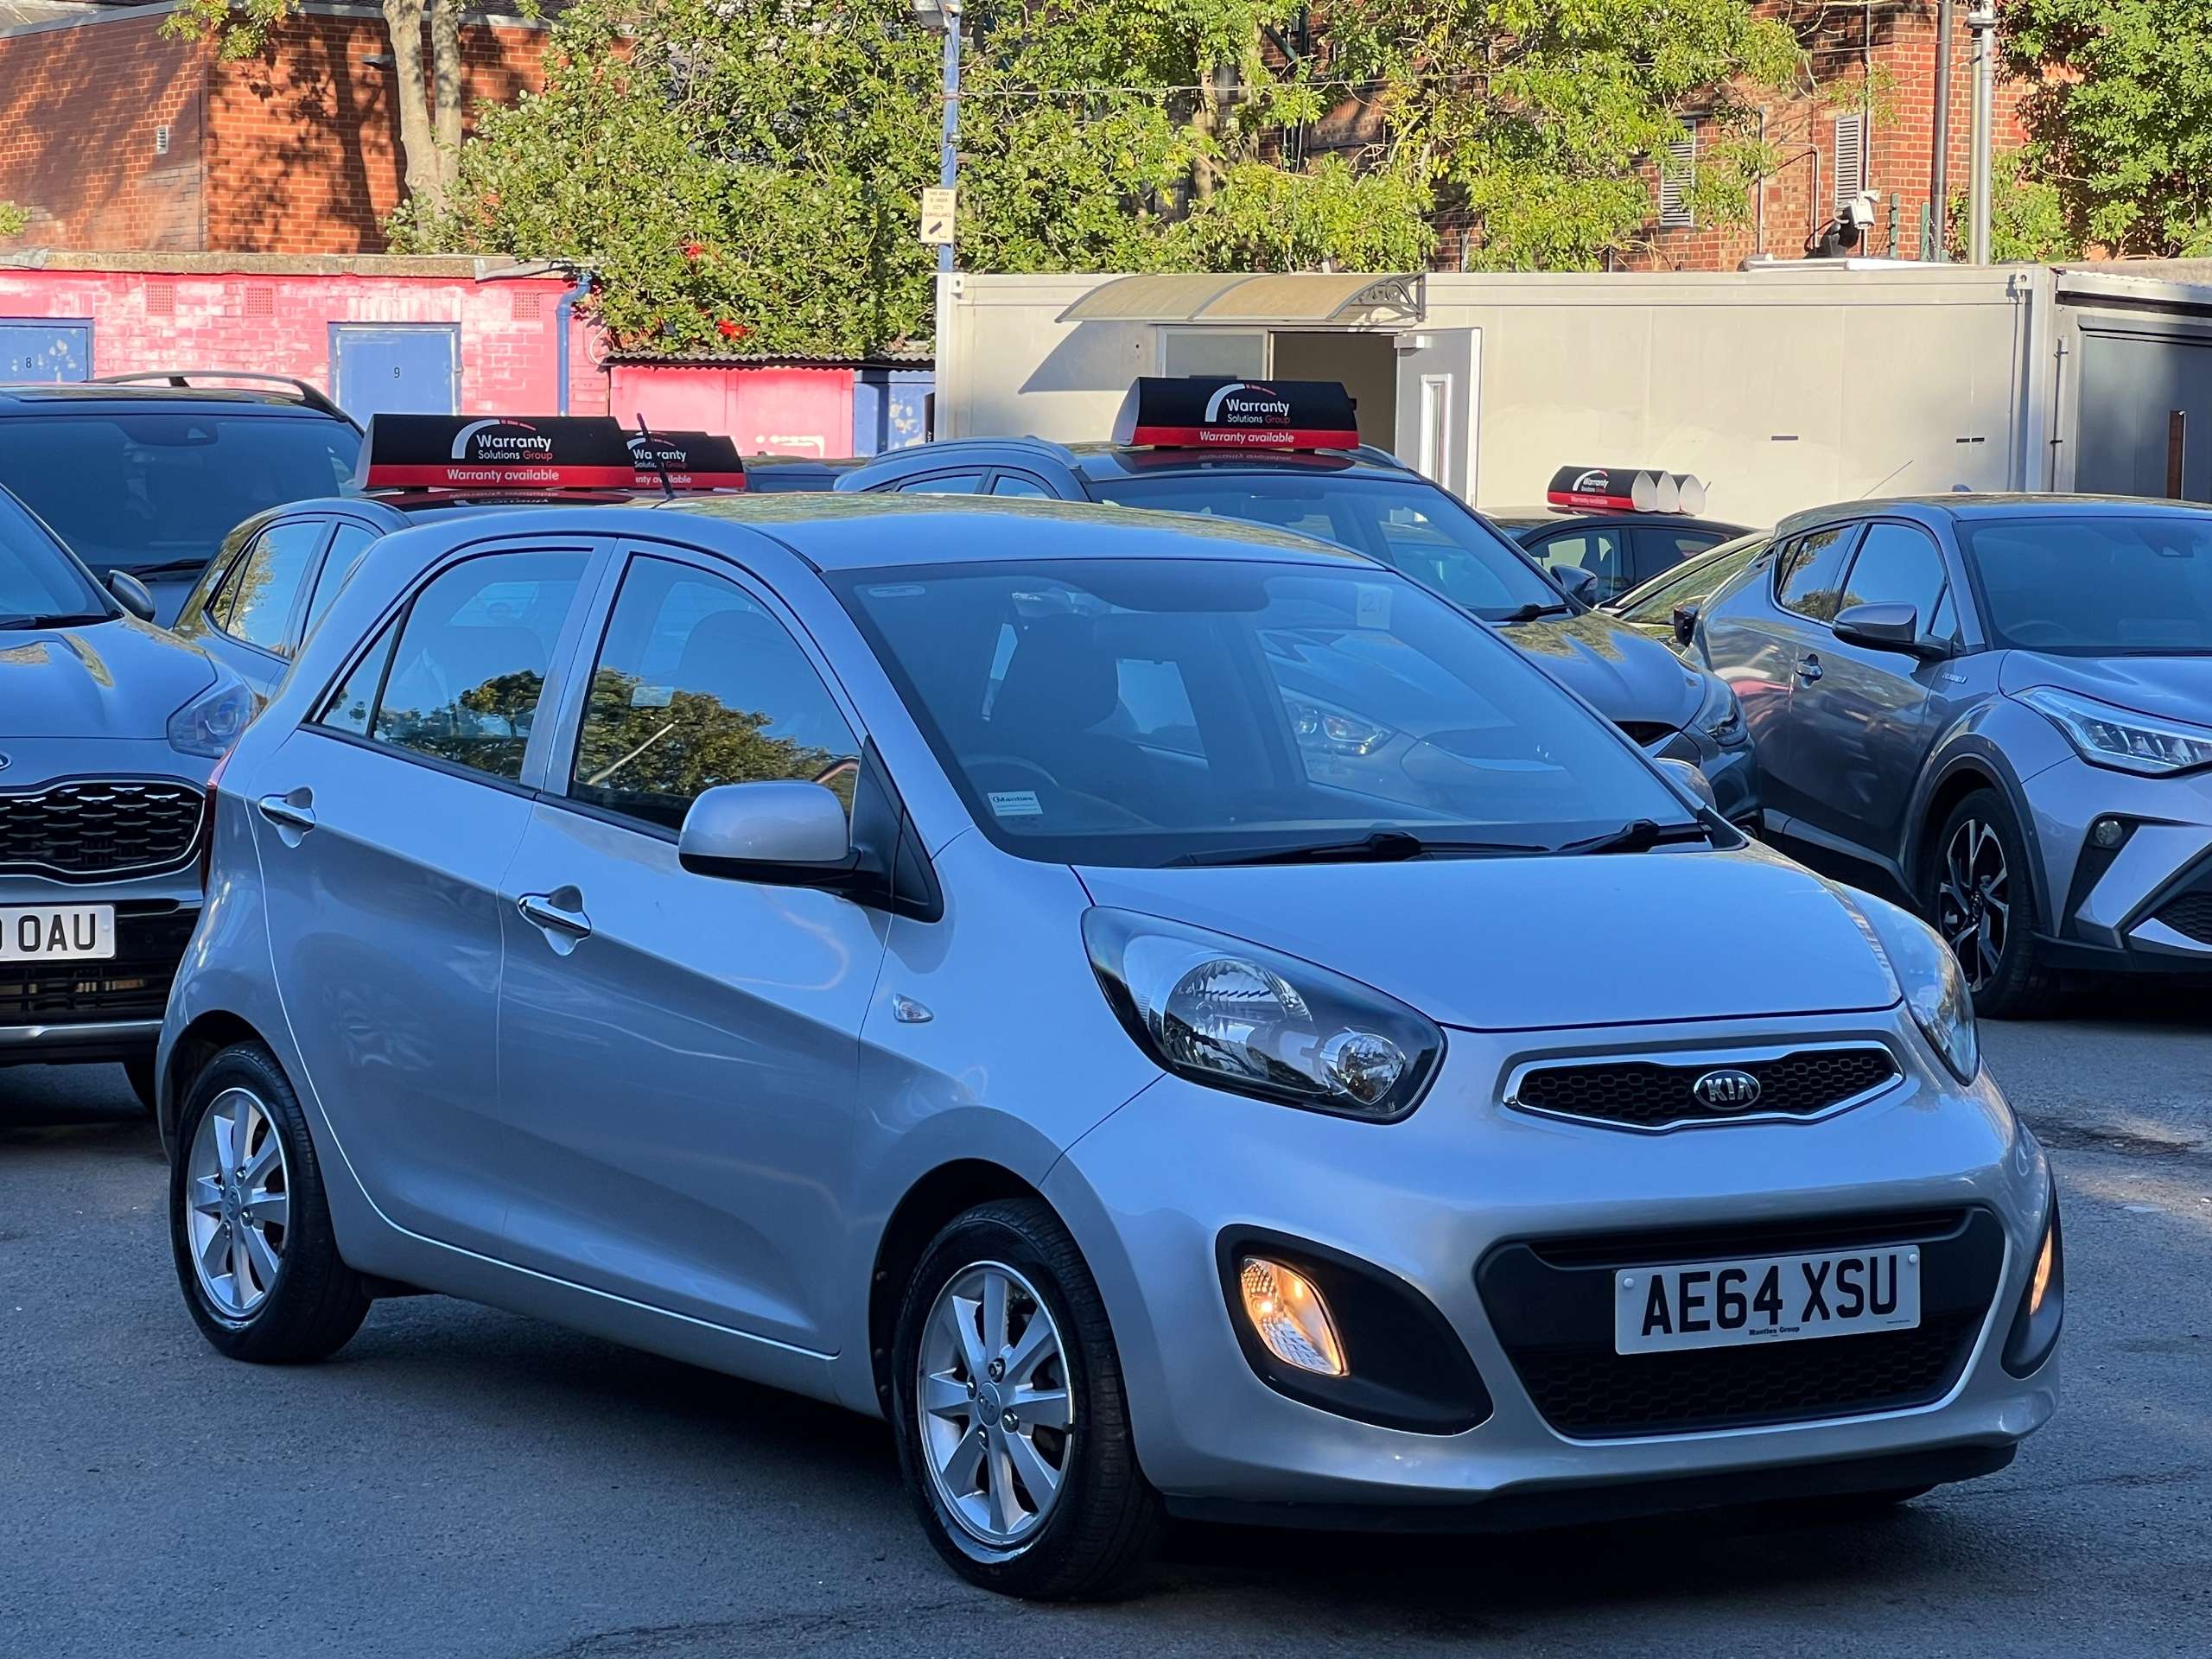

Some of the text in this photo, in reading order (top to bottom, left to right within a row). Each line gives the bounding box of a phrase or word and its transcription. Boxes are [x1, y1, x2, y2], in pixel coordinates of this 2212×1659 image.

[26, 357, 32, 368] 8
[394, 366, 400, 378] 9
[1226, 398, 1290, 416] Warranty
[1227, 413, 1291, 425] Solutions Group
[476, 434, 552, 452] Warranty
[1199, 431, 1294, 445] Warranty available
[478, 450, 553, 461] Solutions Group
[632, 448, 687, 462] Waranty
[447, 468, 559, 484] Warranty available
[18, 913, 96, 952] OAU
[1705, 1077, 1754, 1103] KIA
[1641, 1254, 1897, 1337] AE64 XSU
